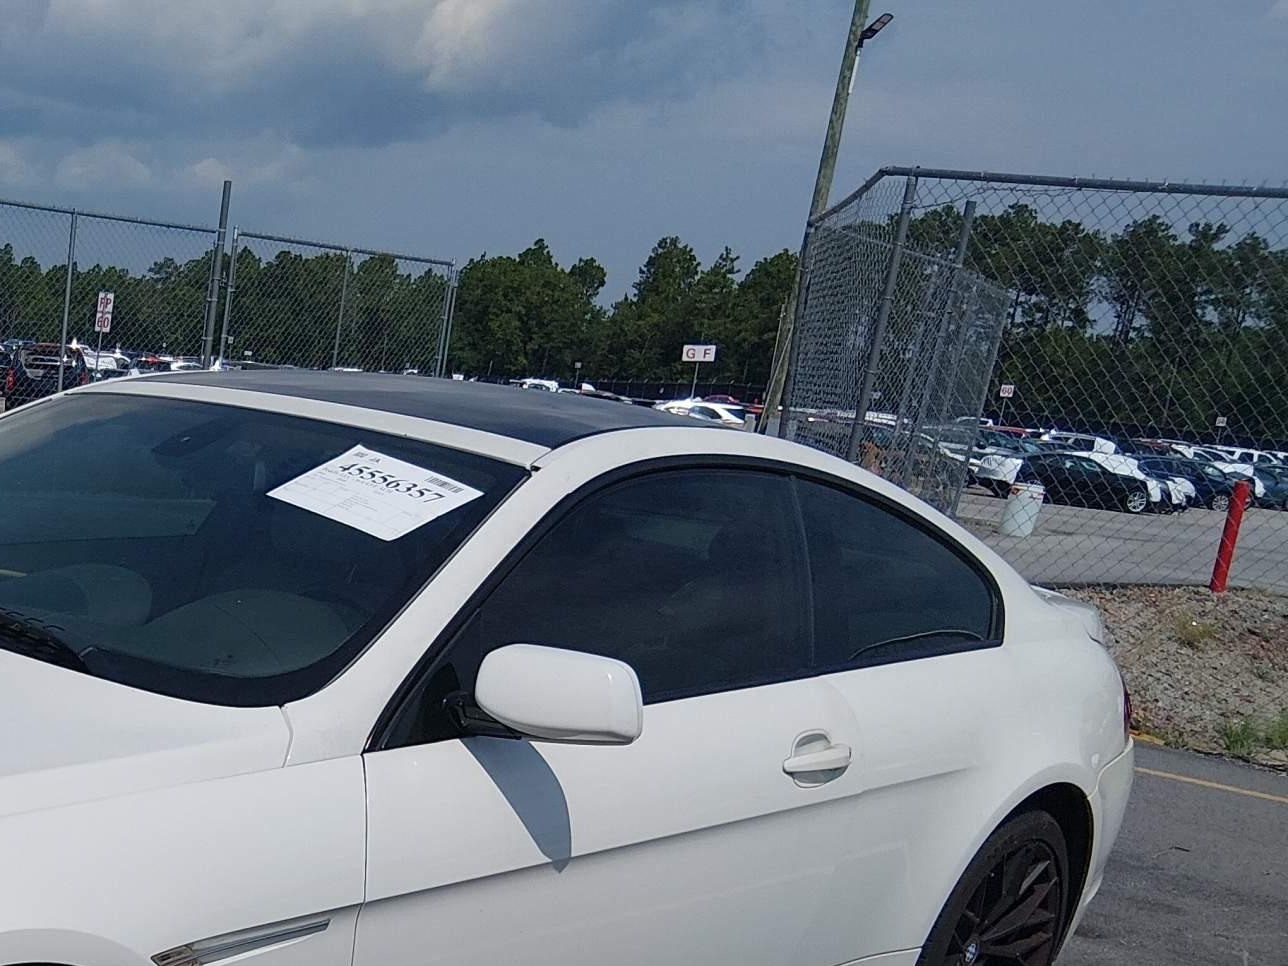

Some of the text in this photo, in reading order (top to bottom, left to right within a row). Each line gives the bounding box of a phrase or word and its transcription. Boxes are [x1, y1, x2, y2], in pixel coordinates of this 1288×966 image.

[97, 316, 110, 329] 60
[686, 348, 712, 359] G F
[338, 462, 446, 503] 45556357
